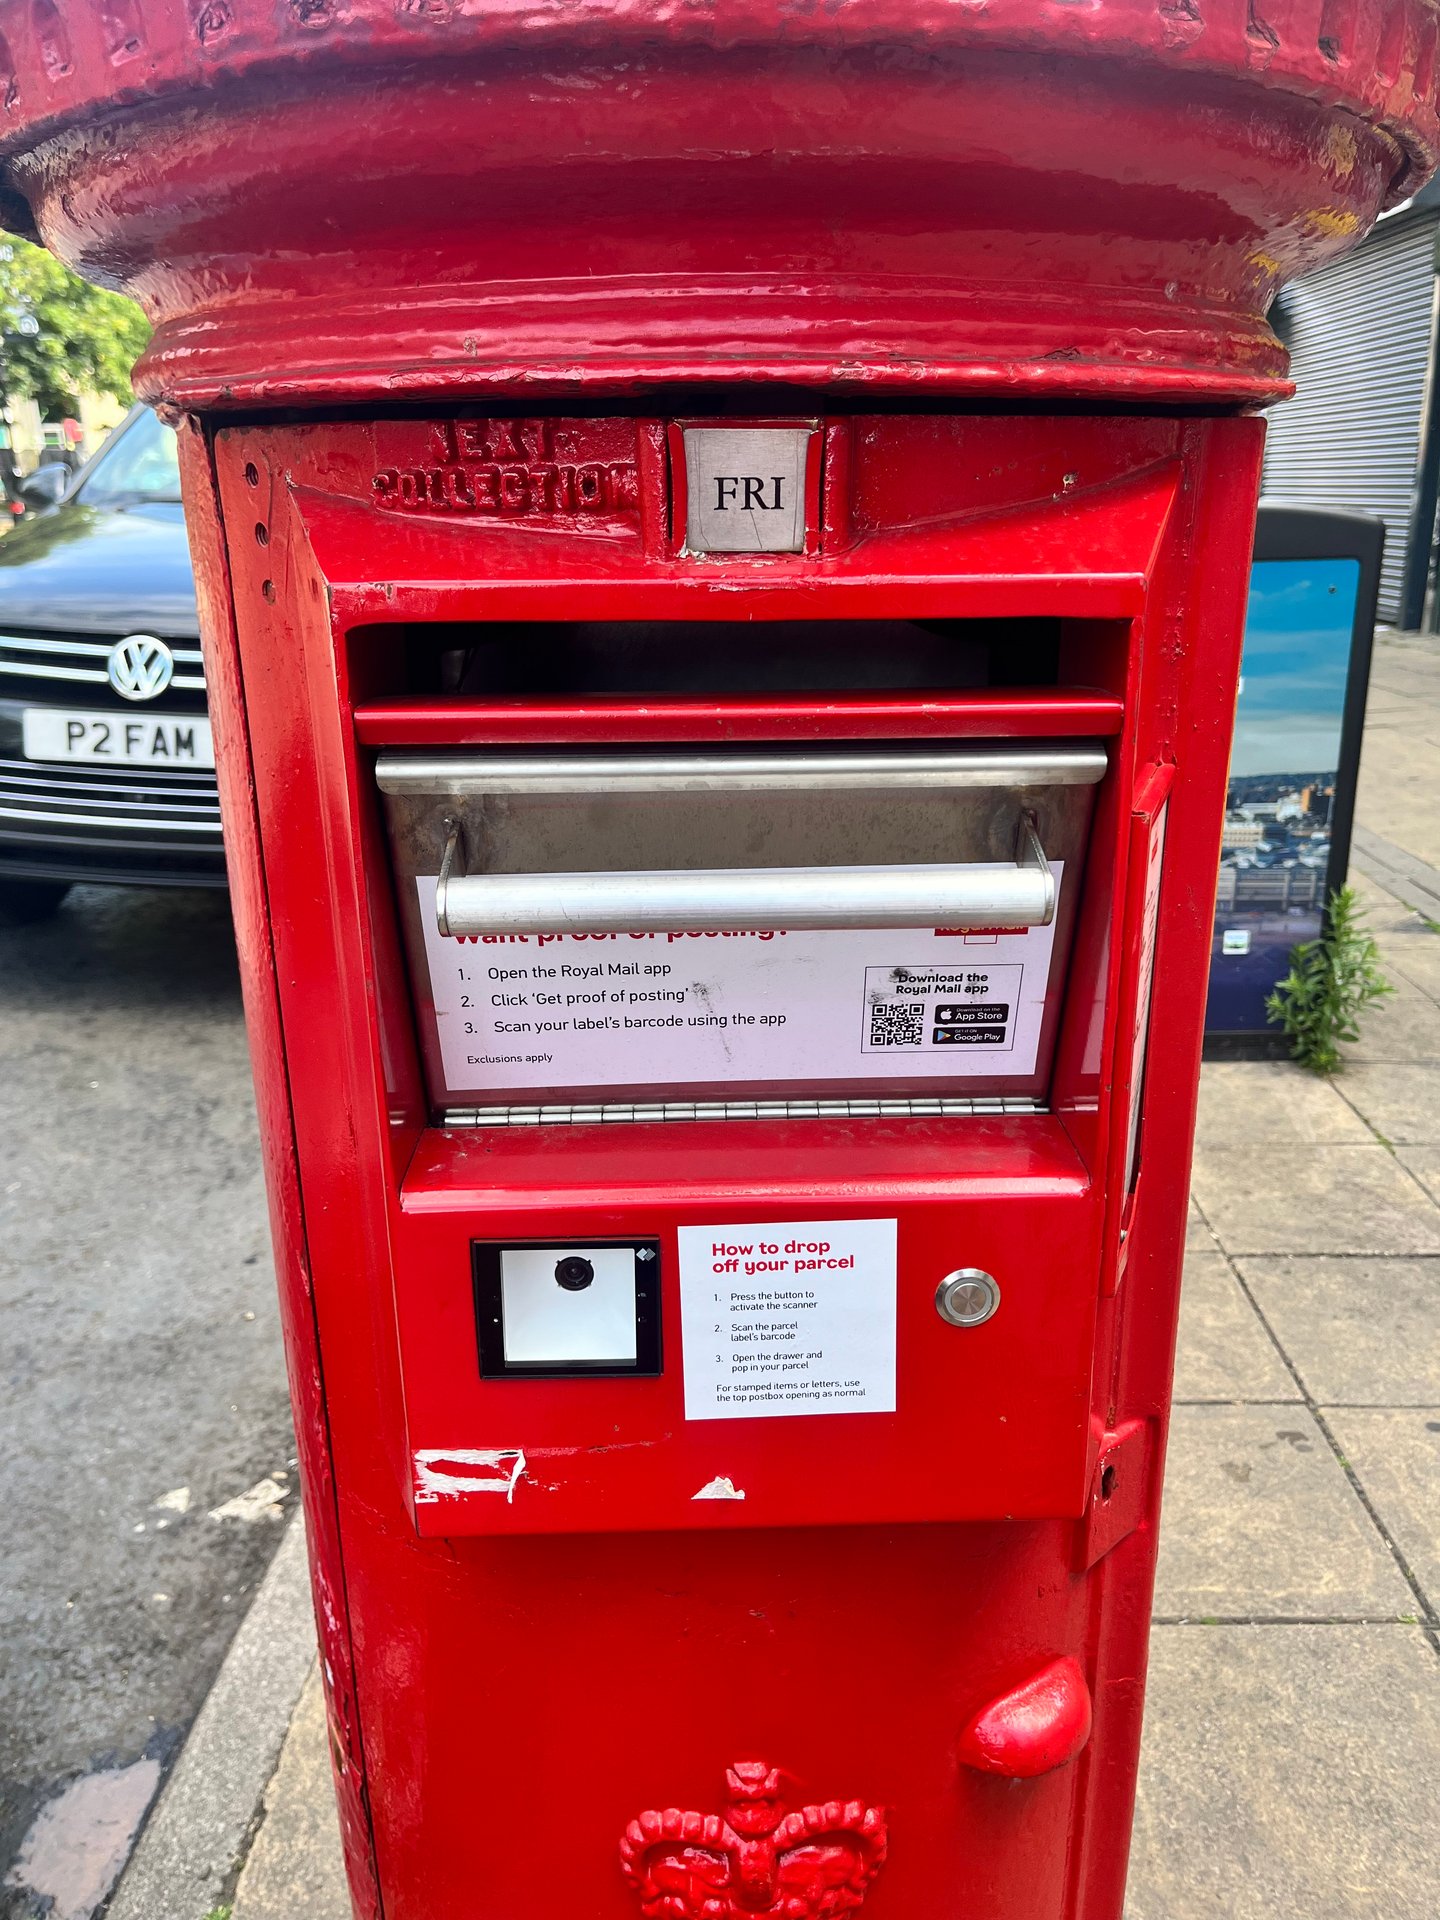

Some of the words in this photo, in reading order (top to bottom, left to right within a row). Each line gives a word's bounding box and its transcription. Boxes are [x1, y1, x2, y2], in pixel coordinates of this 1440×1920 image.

[714, 477, 785, 510] FRI
[68, 722, 110, 752] P2
[126, 726, 194, 757] FAM
[458, 969, 470, 980] 1.
[488, 968, 527, 982] Open
[532, 966, 556, 977] the
[561, 964, 603, 979] Royal
[608, 963, 639, 975] Mail
[644, 965, 671, 977] app
[898, 973, 963, 983] Download
[967, 974, 988, 982] the
[896, 986, 930, 995] Royal
[935, 985, 960, 993] Mail
[965, 985, 988, 994] app
[461, 996, 474, 1007] 2.
[492, 994, 528, 1006] Click
[532, 993, 562, 1004] ‘Get
[567, 990, 606, 1006] proof
[611, 990, 625, 1002] of
[630, 988, 688, 1004] posting’
[955, 1012, 975, 1021] App
[977, 1012, 1003, 1020] Store
[465, 1022, 477, 1033] 3.
[495, 1021, 530, 1032] Scan
[535, 1022, 569, 1034] your
[574, 1017, 620, 1029] label’s
[625, 1015, 683, 1028] barcode
[688, 1014, 727, 1028] using
[732, 1013, 755, 1024] the
[760, 1015, 786, 1026] app
[954, 1033, 983, 1042] Google
[984, 1033, 1001, 1041] Play
[468, 1055, 522, 1064] Exclusions
[526, 1053, 552, 1063] apply
[713, 1243, 753, 1256] How
[759, 1243, 778, 1255] to
[785, 1240, 830, 1255] drop
[713, 1259, 739, 1273] off
[745, 1261, 789, 1275] your
[795, 1255, 853, 1273] parcel
[714, 1294, 721, 1302] 1.
[775, 1291, 803, 1299] button
[730, 1303, 764, 1311] activate
[771, 1322, 798, 1331] parcel
[731, 1333, 758, 1341] label’s
[761, 1332, 795, 1341] barcode
[733, 1354, 755, 1363] Open
[774, 1352, 803, 1360] drawer
[732, 1365, 748, 1373] pop
[760, 1363, 780, 1372] your
[783, 1362, 808, 1371] parcel
[717, 1384, 731, 1392] For
[734, 1383, 771, 1392] stamped
[812, 1380, 842, 1388] letters,
[717, 1394, 730, 1402] the
[733, 1394, 746, 1402] top
[749, 1392, 783, 1402] postbox
[786, 1391, 820, 1400] opening
[822, 1390, 832, 1398] as
